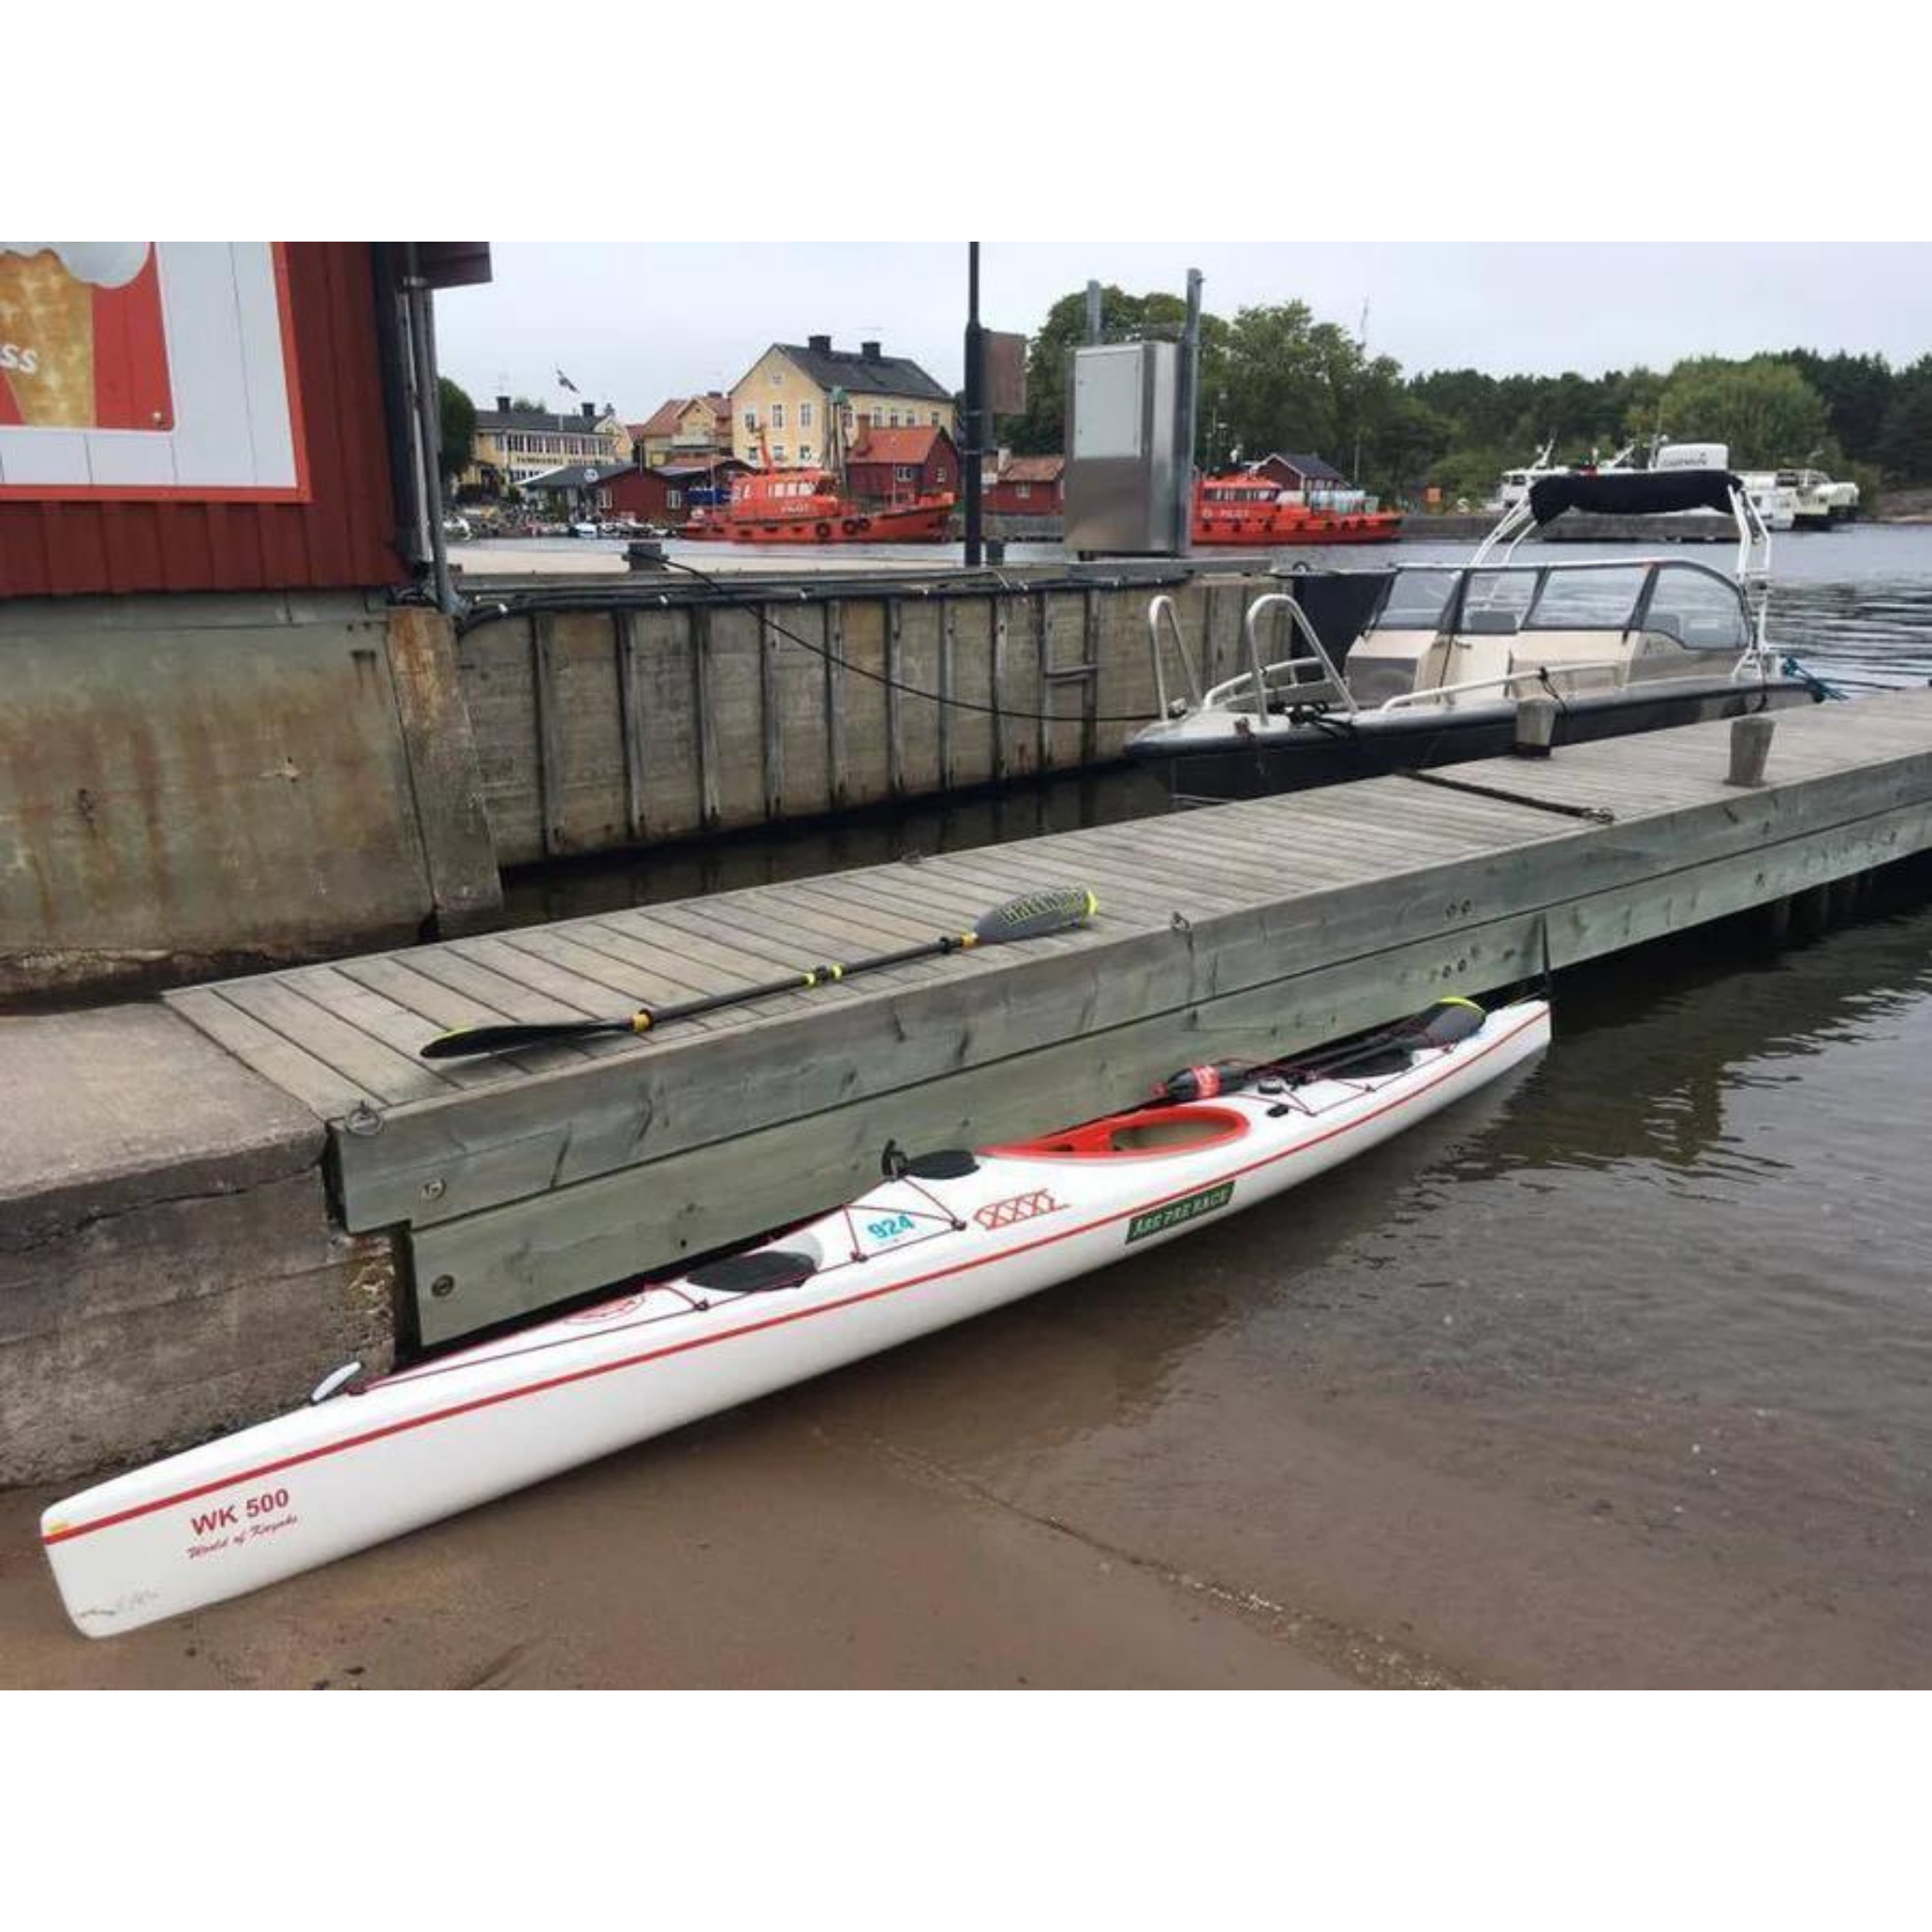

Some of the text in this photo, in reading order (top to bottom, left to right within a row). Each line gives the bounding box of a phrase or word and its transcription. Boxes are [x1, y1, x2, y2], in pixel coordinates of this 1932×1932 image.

[867, 1215, 915, 1239] 924
[190, 1488, 289, 1536] WK 500
[186, 1537, 229, 1559] World
[233, 1529, 246, 1546] of
